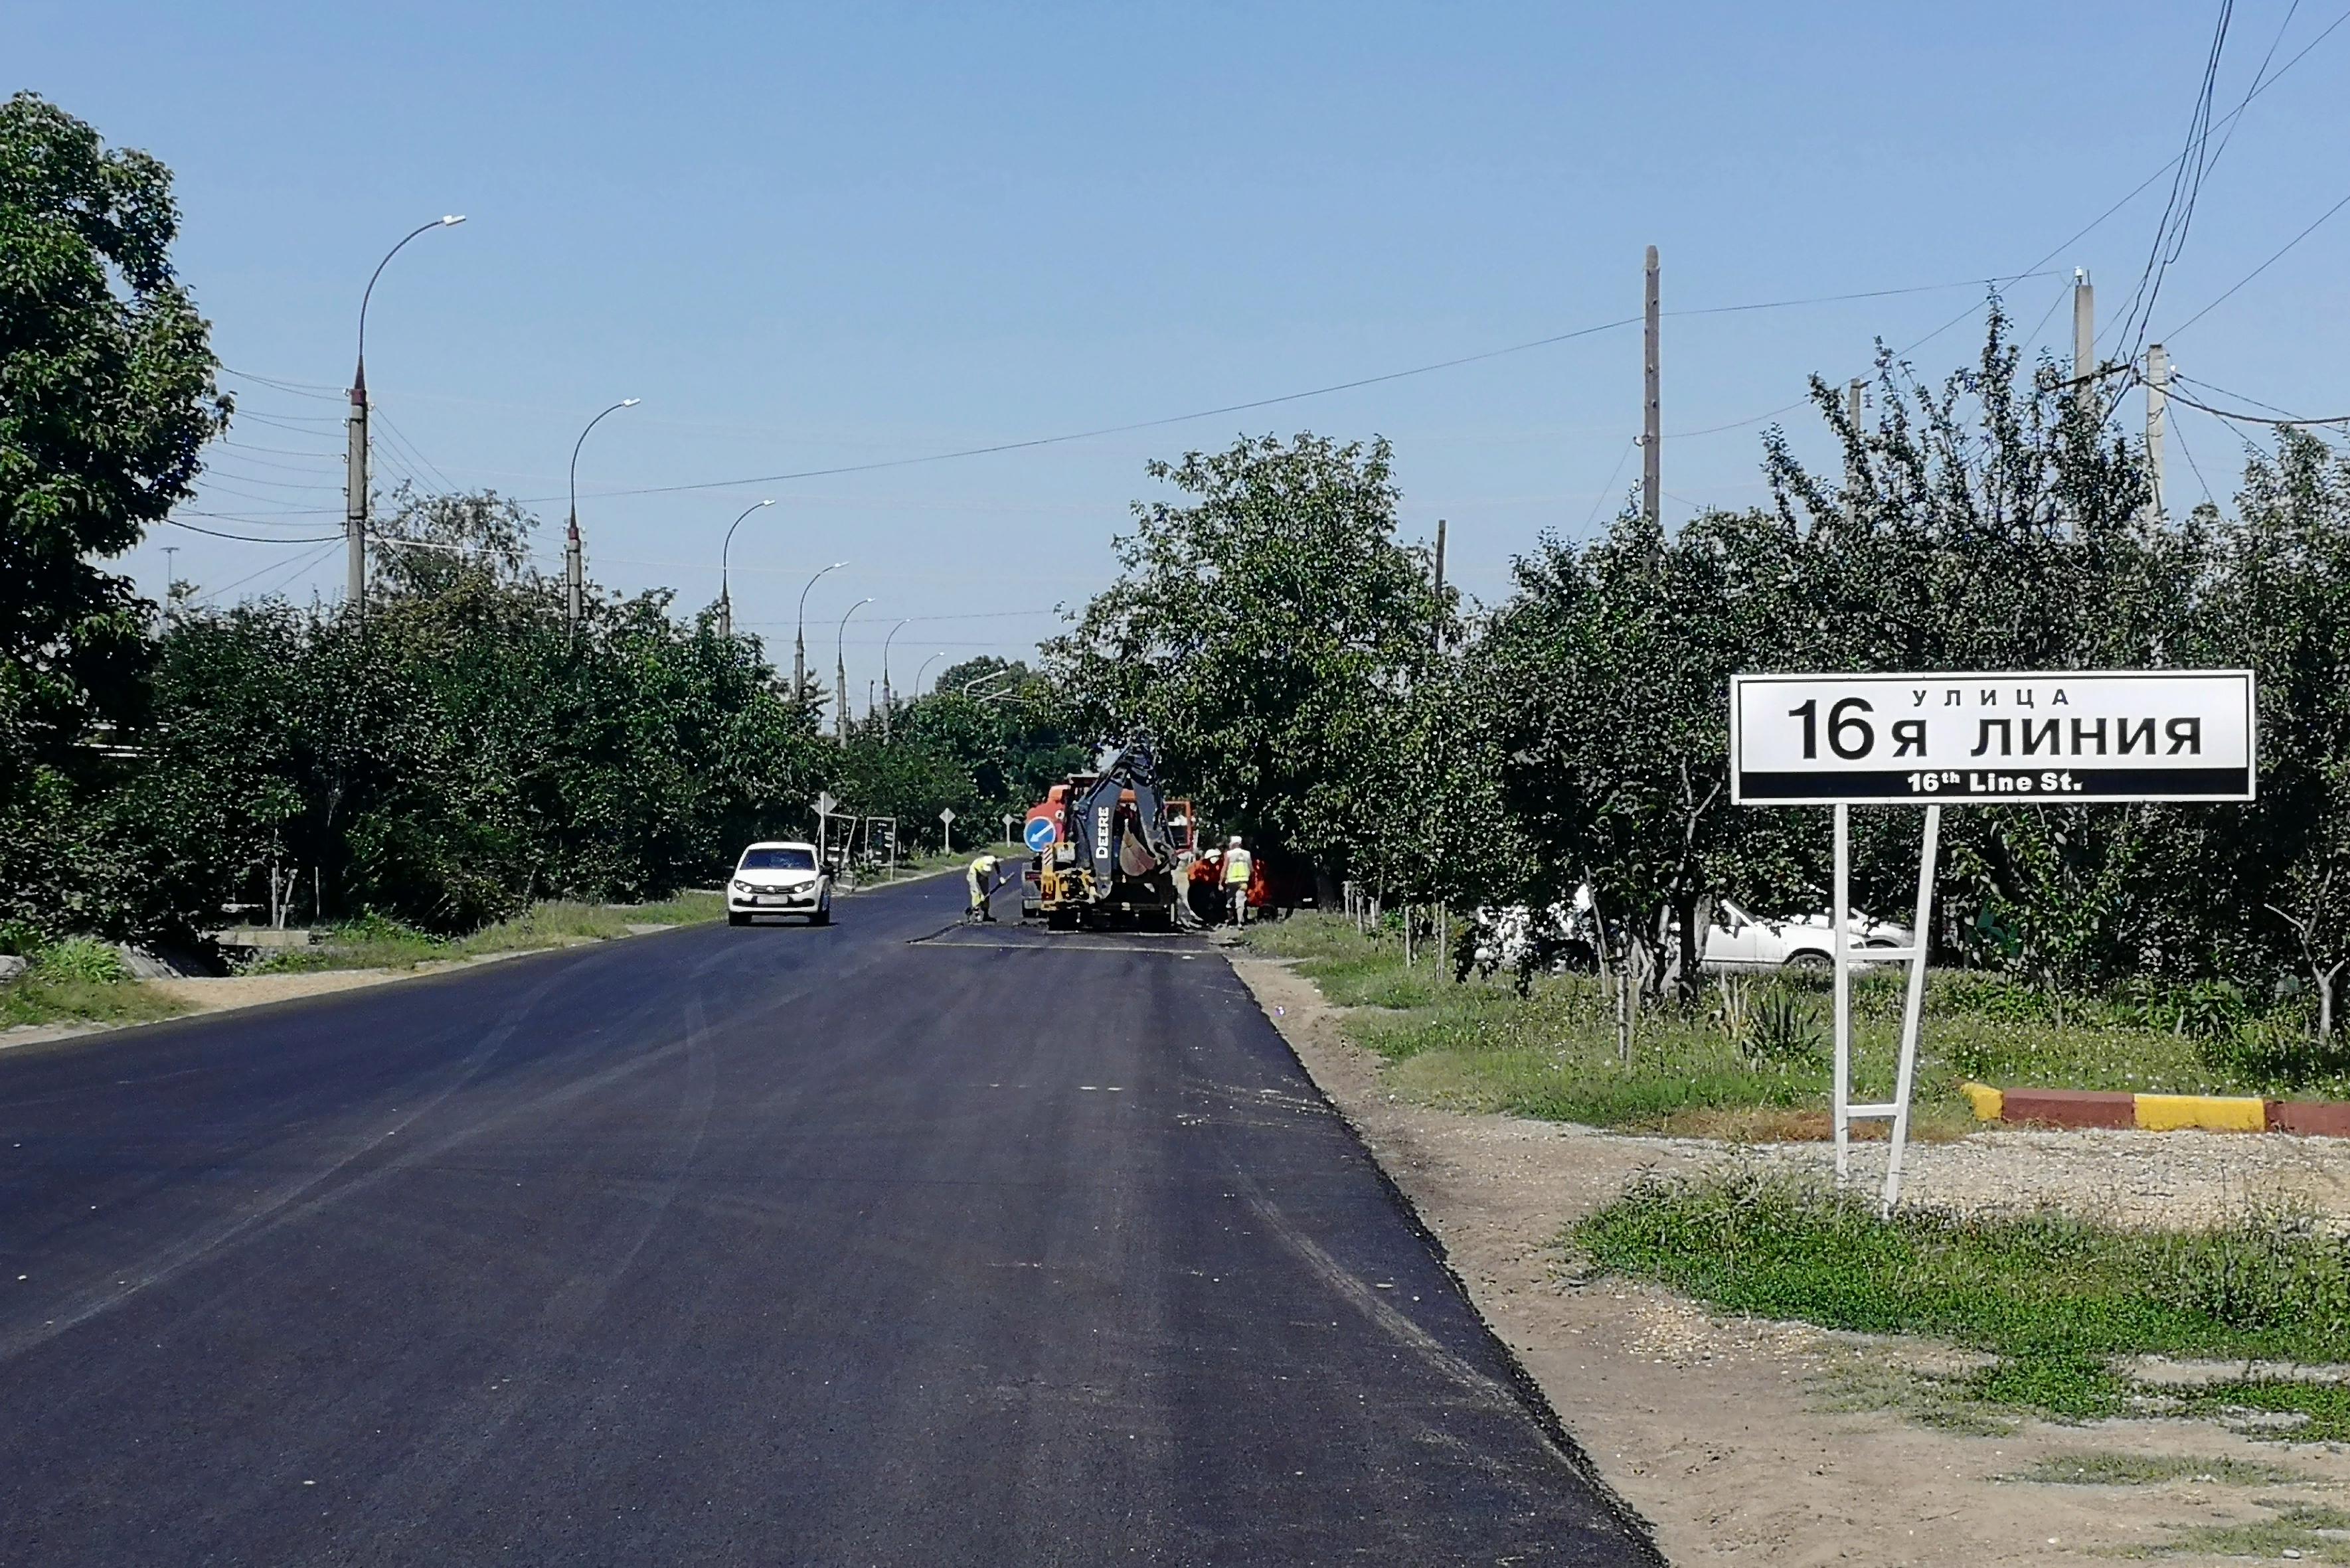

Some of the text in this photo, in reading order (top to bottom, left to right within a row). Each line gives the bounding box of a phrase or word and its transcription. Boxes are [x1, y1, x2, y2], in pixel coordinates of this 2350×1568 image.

[1913, 689, 2068, 708] УЛИЦА
[1970, 717, 2201, 757] ЛИНИЯ
[1907, 771, 2083, 792] 16th Line St.
[1096, 807, 1109, 859] DEERE
